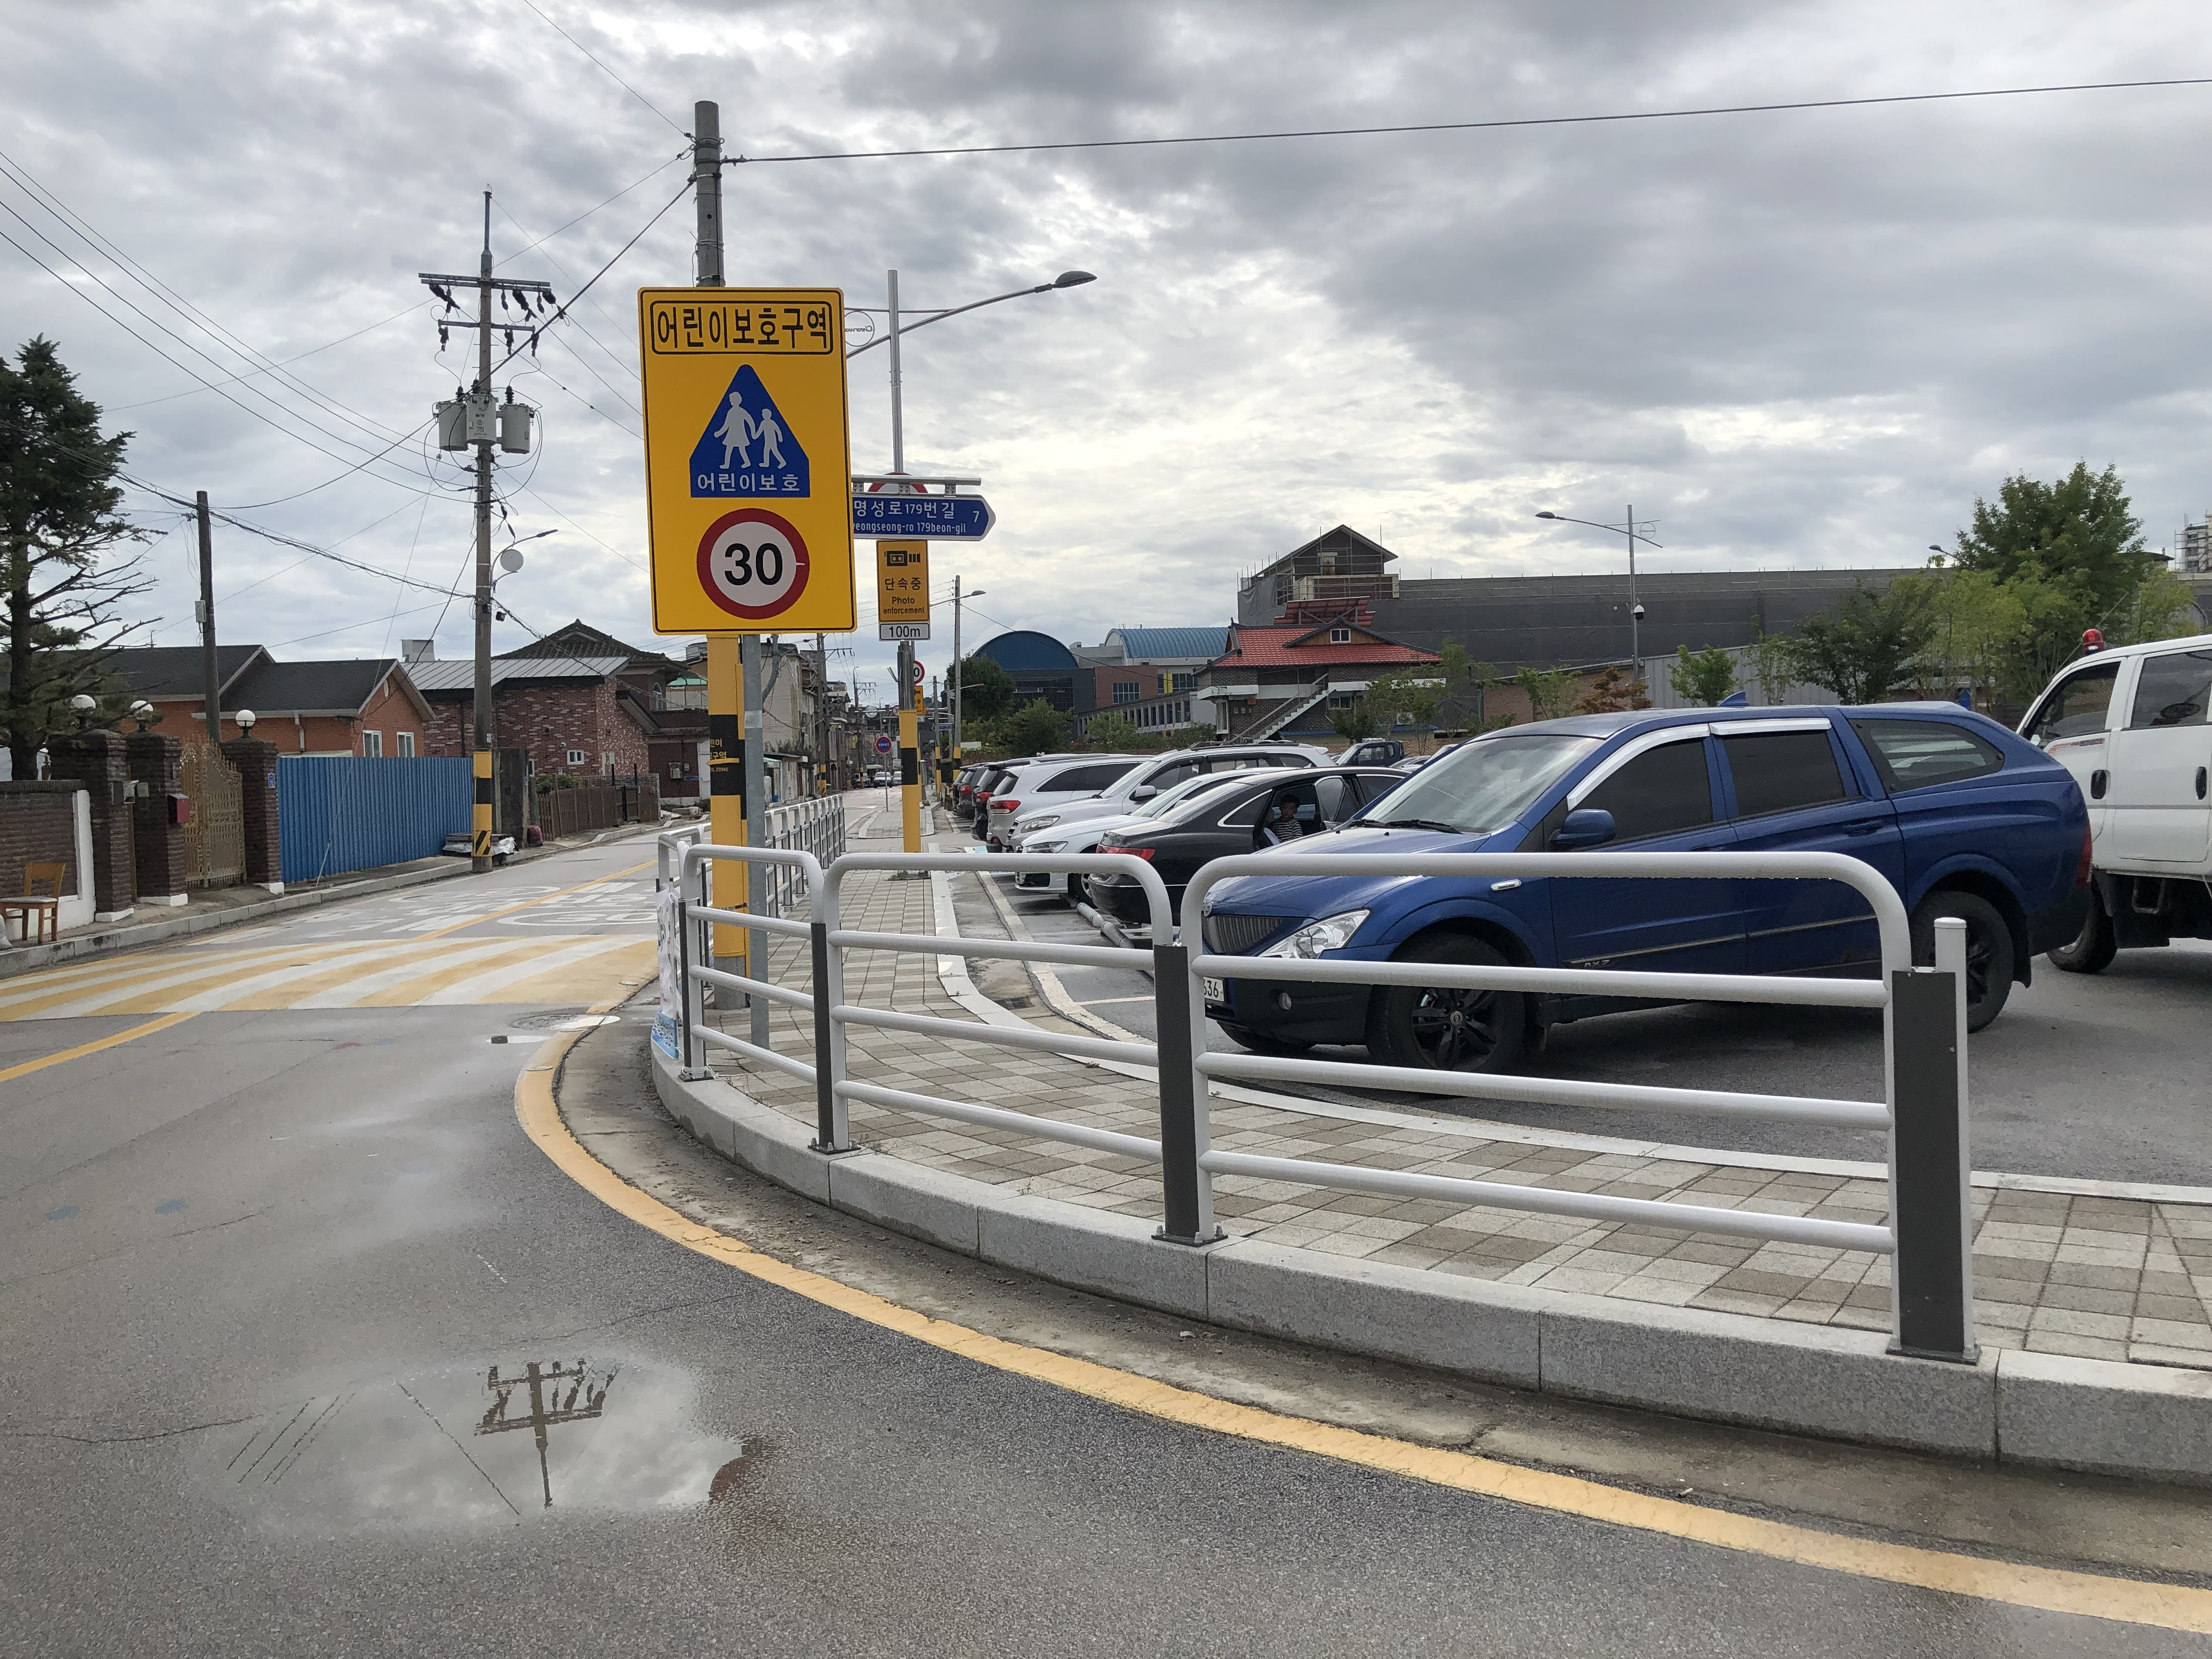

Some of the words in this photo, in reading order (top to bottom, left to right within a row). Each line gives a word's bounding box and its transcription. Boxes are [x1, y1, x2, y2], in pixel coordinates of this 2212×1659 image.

[658, 307, 827, 348] 어린이보호구역
[697, 472, 800, 492] 어린이보호
[973, 511, 980, 523] 7
[854, 522, 914, 534] eongseong-ro
[917, 522, 966, 535] 179beon-gil
[724, 543, 783, 586] 30
[884, 577, 921, 591] 단속중
[891, 596, 915, 605] Photo
[883, 606, 924, 614] enforcement
[889, 626, 921, 637] 100m
[913, 668, 920, 677] 0
[710, 738, 723, 748] 린이
